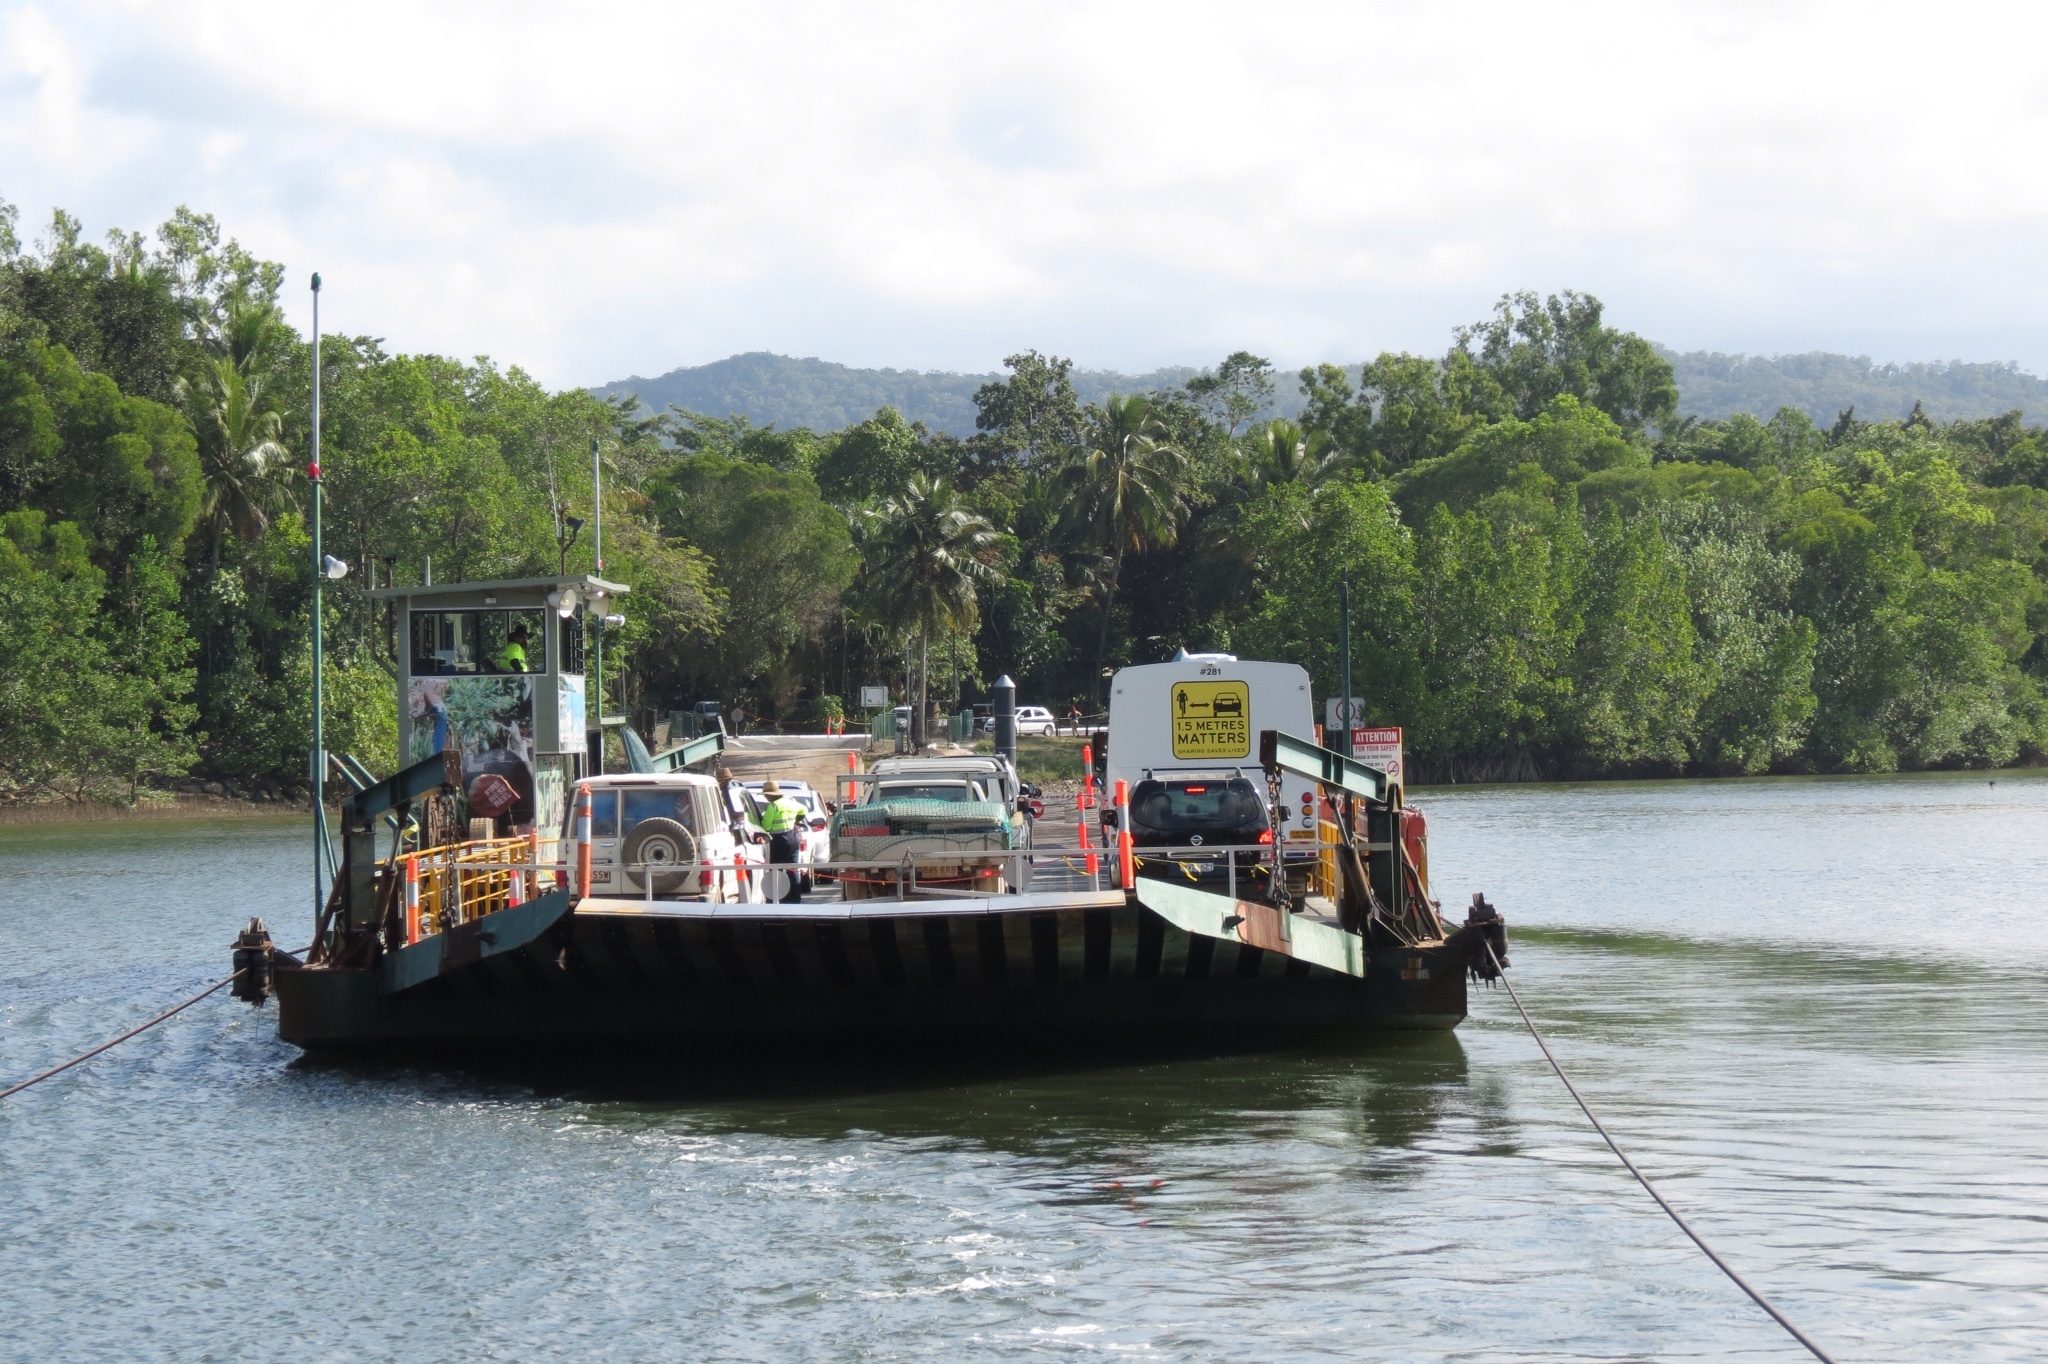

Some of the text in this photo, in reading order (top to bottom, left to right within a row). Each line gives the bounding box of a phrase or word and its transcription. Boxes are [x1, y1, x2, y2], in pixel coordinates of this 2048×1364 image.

[1177, 720, 1245, 731] 1.5 METRES
[1177, 732, 1246, 744] MATTERS
[1355, 731, 1398, 743] ATTENTION
[484, 779, 502, 796] FIRE
[488, 783, 508, 803] HOSE
[493, 791, 512, 808] REEL
